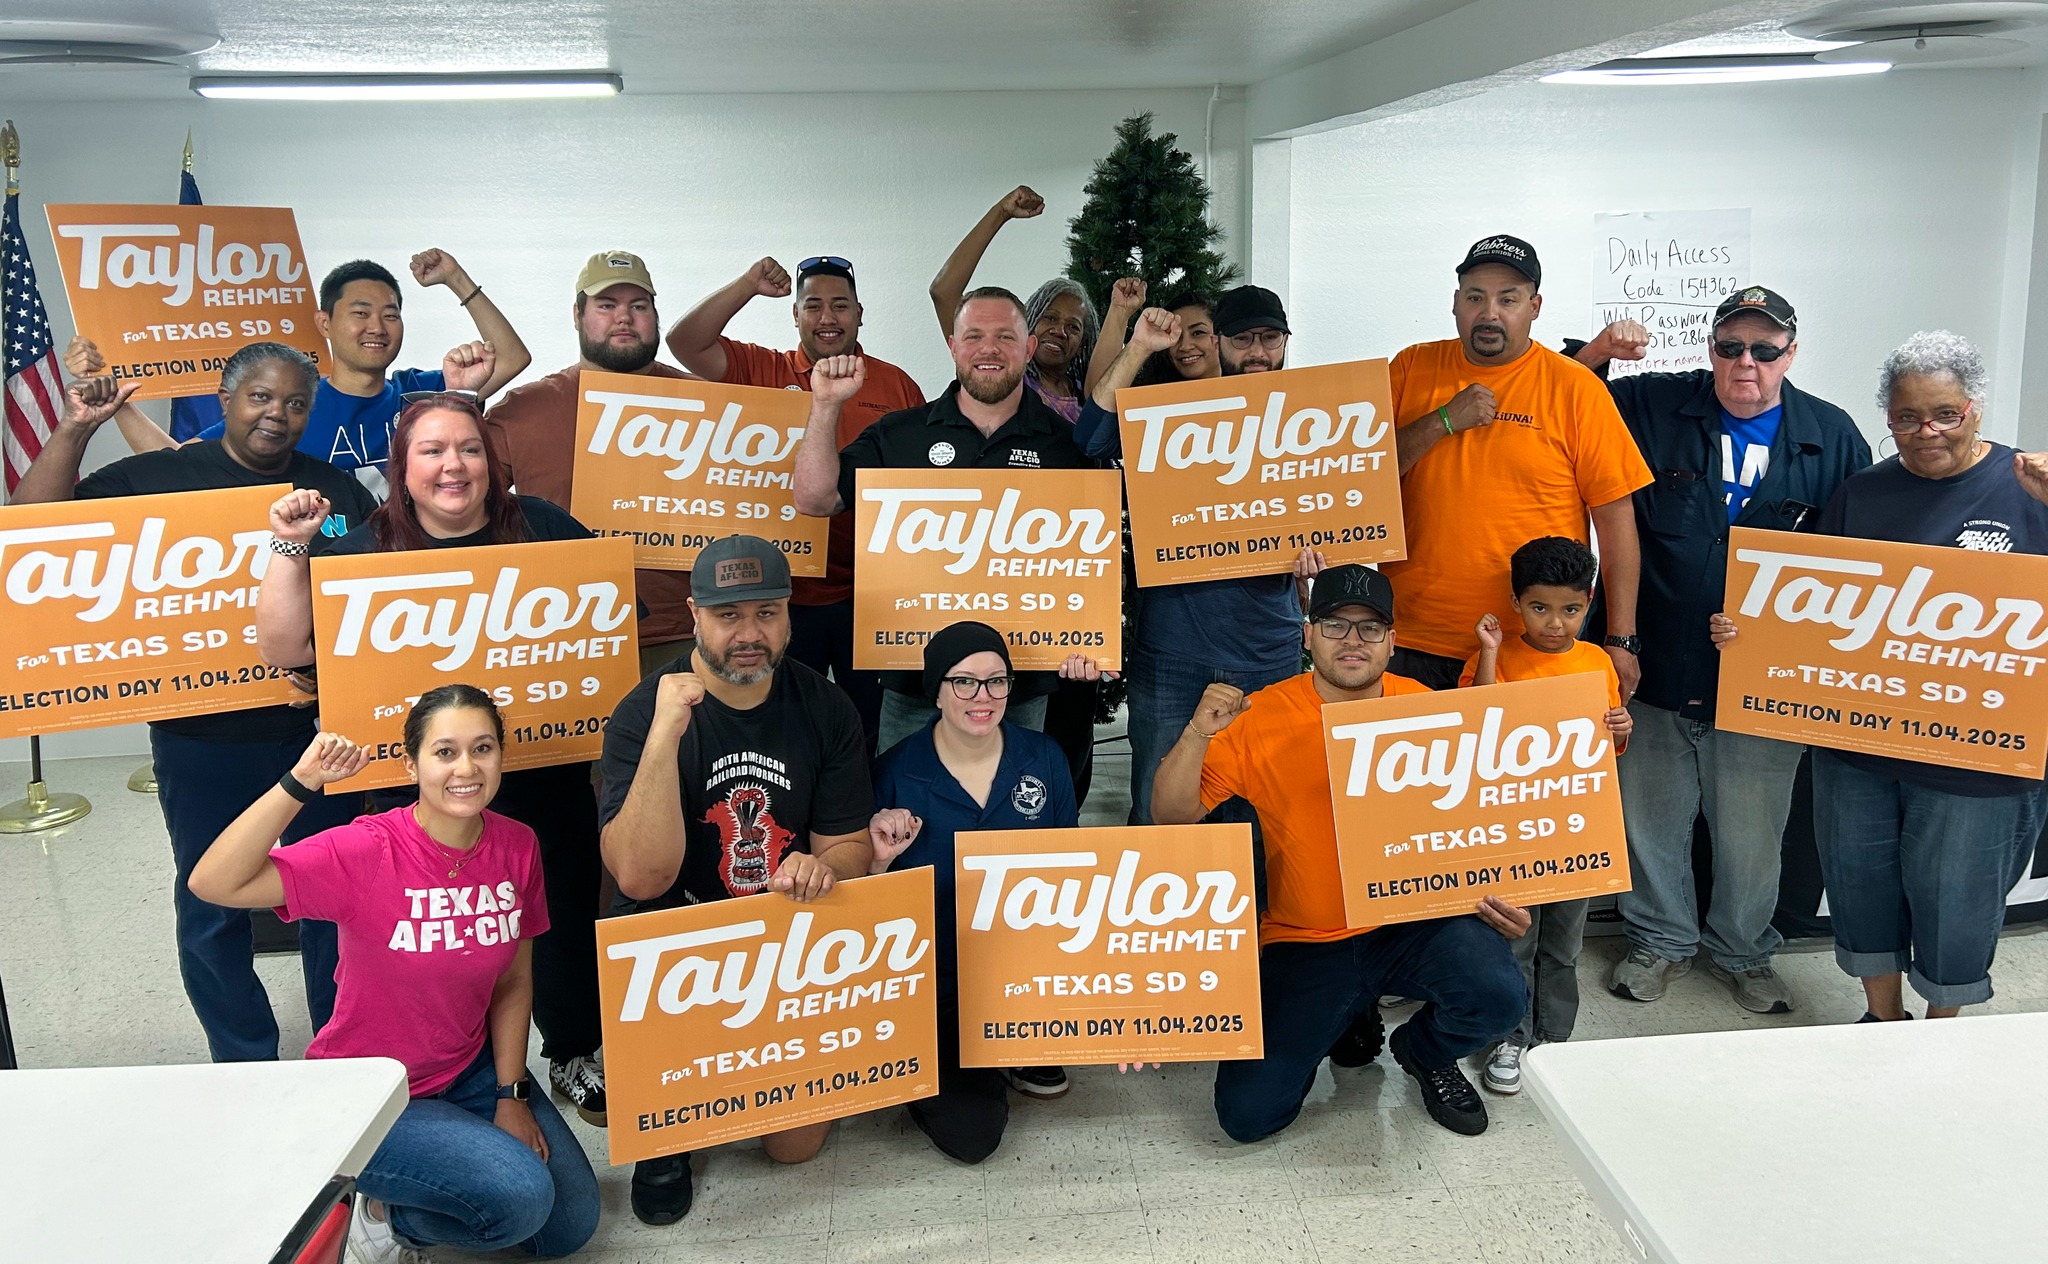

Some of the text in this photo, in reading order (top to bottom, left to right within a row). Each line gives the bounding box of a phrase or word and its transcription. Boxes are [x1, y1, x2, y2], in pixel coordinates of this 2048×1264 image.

[58, 224, 306, 306] Taylor
[1473, 240, 1527, 257] Laborers
[1608, 237, 1731, 274] Daily Access
[204, 288, 306, 306] REHMET
[1680, 277, 1739, 299] 154362
[123, 319, 294, 343] For TEXAS SD 9
[111, 360, 197, 379] ELECTION
[1675, 355, 1705, 367] name
[1011, 448, 1038, 458] TEXAS
[1125, 392, 1388, 484] Taylor
[705, 467, 795, 490] REHM
[1261, 452, 1386, 482] REHMET
[613, 496, 796, 521] For TEXAS SD 9
[1172, 490, 1362, 526] For TEXAS SD 9
[862, 488, 1116, 576] Taylor
[1157, 525, 1386, 562] ELECTION DAY 11.04.2025
[721, 562, 756, 573] TEXAS
[988, 558, 1111, 576] REHMET
[134, 586, 260, 620] REHM
[896, 593, 1084, 611] For TEXAS SD 9
[1737, 549, 2048, 651] Taylor
[321, 567, 631, 671] Taylor
[17, 625, 257, 670] For TEXAS SD 9
[486, 636, 627, 669] REHMET
[875, 631, 1103, 645] ELECTI 11.04.2025
[1882, 640, 2046, 676] REHMET
[0, 684, 109, 711] ELECTION
[118, 679, 161, 697] DAY
[374, 705, 404, 719] For
[527, 681, 567, 702] SD
[582, 677, 600, 695] 9
[1768, 665, 2004, 708] For TEXAS SD 9
[514, 716, 610, 743] 11.04.20
[1743, 696, 1840, 723] ELECTION
[1850, 712, 1891, 730] DAY
[1901, 720, 2025, 750] 11.04.2025
[740, 751, 785, 774] AMERICAN
[1332, 707, 1608, 810] Taylor
[706, 765, 791, 791] RAILROAD WORKERS
[1480, 772, 1607, 807] REHMET
[1385, 814, 1585, 857] For TEXAS SD 9
[1368, 852, 1610, 898] ELECTION DAY 11.04.2025
[405, 881, 516, 919] TEXAS
[963, 850, 1249, 954] Taylor
[1107, 929, 1246, 954] REHMET
[607, 912, 929, 1028] Taylor
[1005, 971, 1218, 997] For TEXAS SD 9
[777, 973, 924, 1022] REHMET
[984, 1015, 1242, 1038] ELECTION DAY 11.04.2025
[662, 1021, 894, 1085] For TEXAS SD 9
[639, 1095, 745, 1131] ELECTION
[755, 1084, 796, 1107] DAY
[806, 1058, 918, 1096] 11.04.2025
